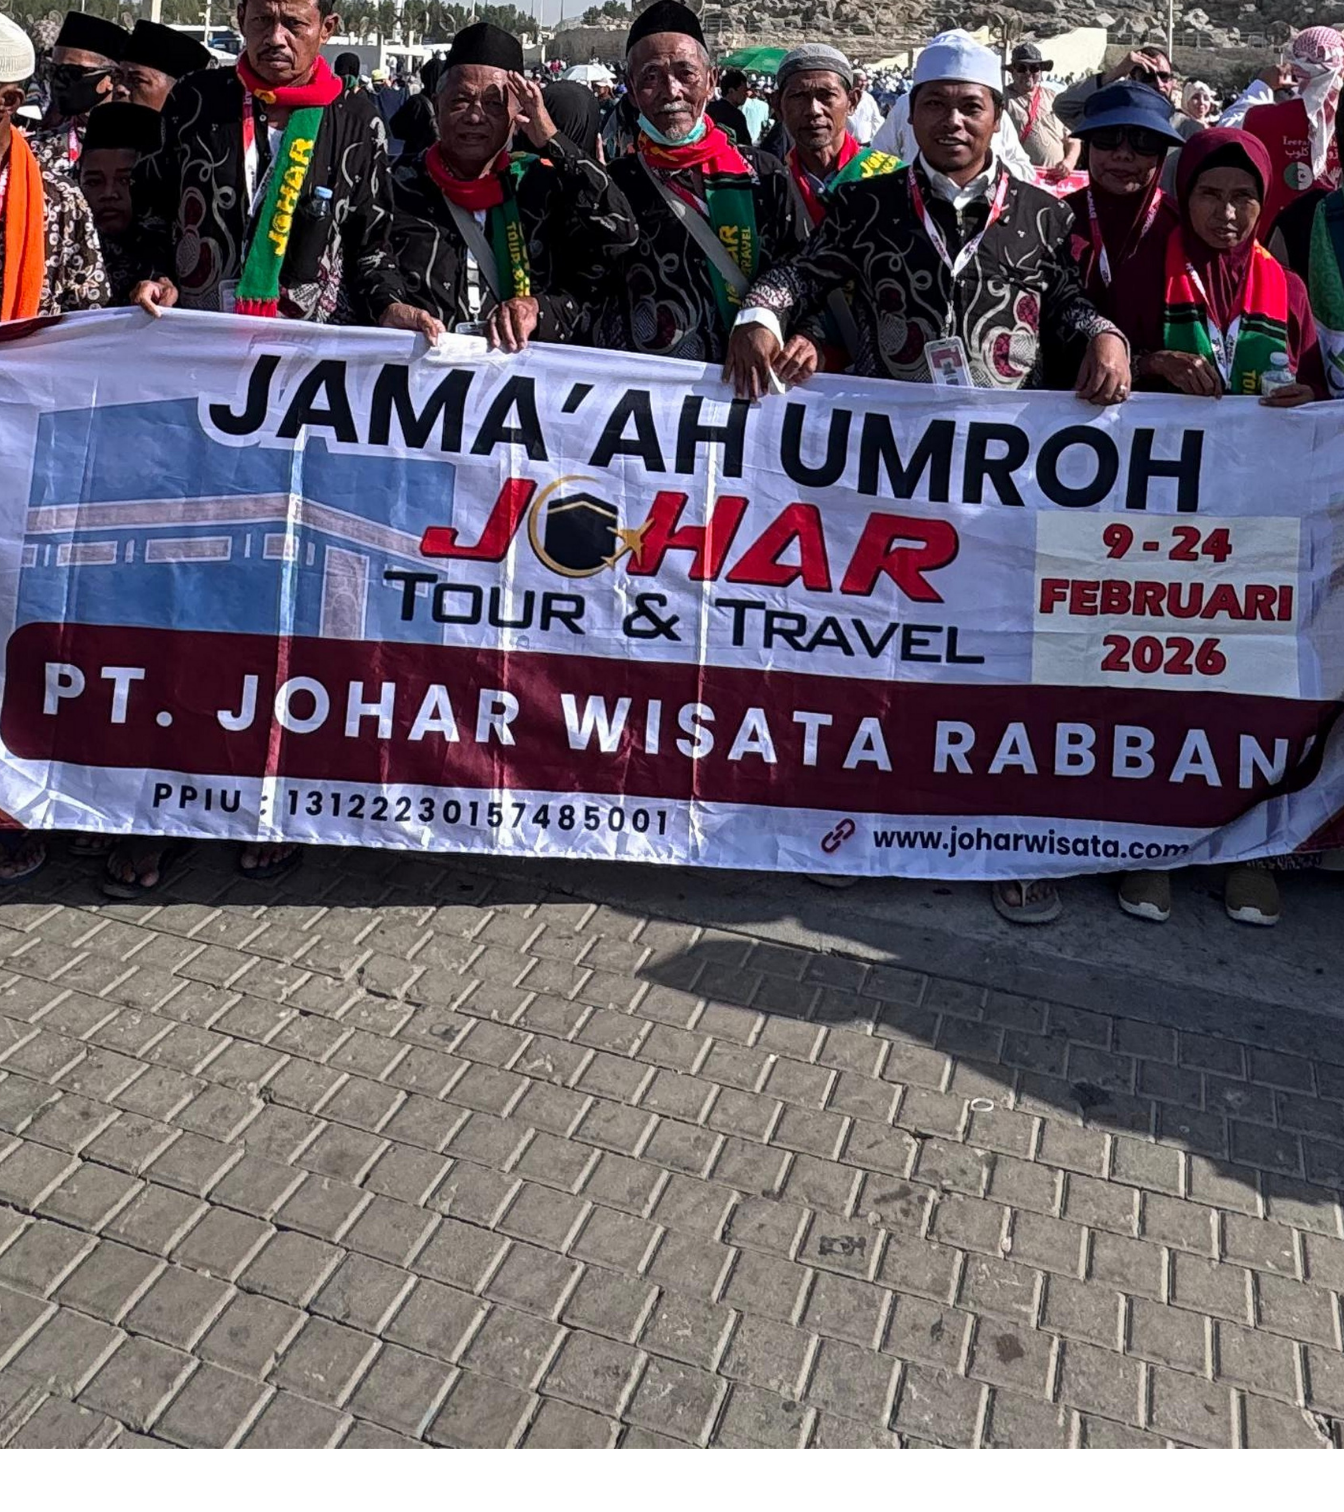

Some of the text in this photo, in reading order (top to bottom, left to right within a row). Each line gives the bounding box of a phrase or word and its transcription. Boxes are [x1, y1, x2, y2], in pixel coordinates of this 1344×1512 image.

[268, 138, 316, 256] JOHAR
[208, 354, 1204, 513] JAMA'AH UMROH
[419, 473, 960, 604] JOHAR
[1103, 523, 1133, 559] 9
[1169, 526, 1232, 562] 24
[384, 570, 985, 665] TOUR & TRAVEL
[1040, 578, 1293, 621] FEBRUARI
[1101, 634, 1227, 675] 2026
[43, 661, 173, 727] PT.
[216, 674, 521, 746] JOHAR
[560, 693, 893, 772] WISATA
[152, 782, 241, 813] PPIU
[288, 789, 669, 835] 13122230157485001
[872, 826, 1190, 860] www.joharwisata.com
